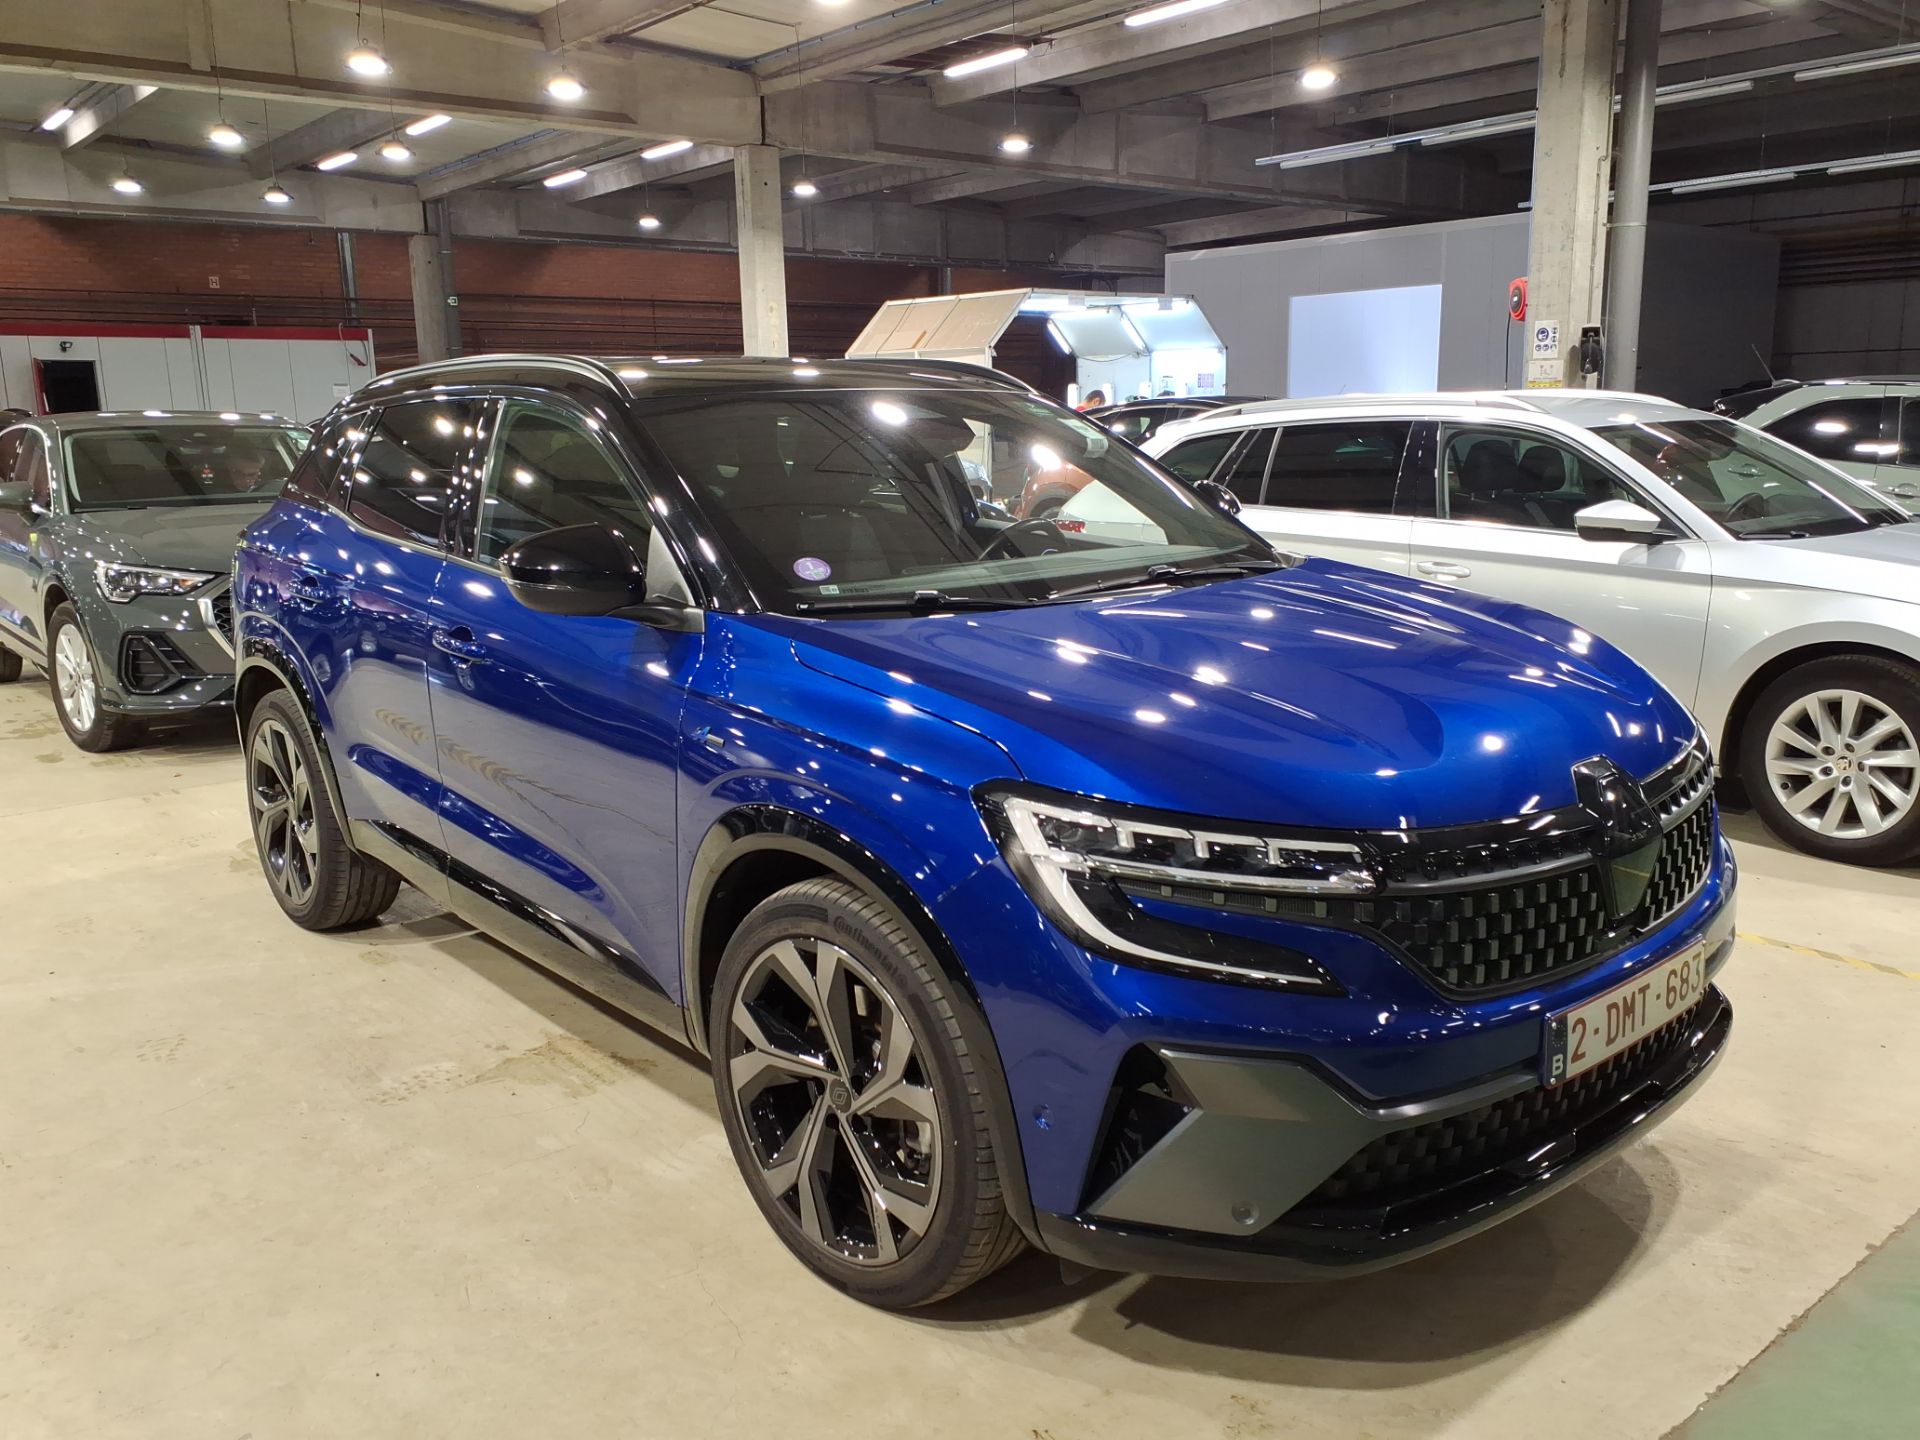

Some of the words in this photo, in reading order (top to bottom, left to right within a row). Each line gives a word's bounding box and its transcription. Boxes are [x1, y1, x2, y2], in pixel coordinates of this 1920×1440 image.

[833, 915, 899, 977] Continental
[1570, 951, 1702, 1065] 2-DMT-683
[1552, 1053, 1564, 1076] B
